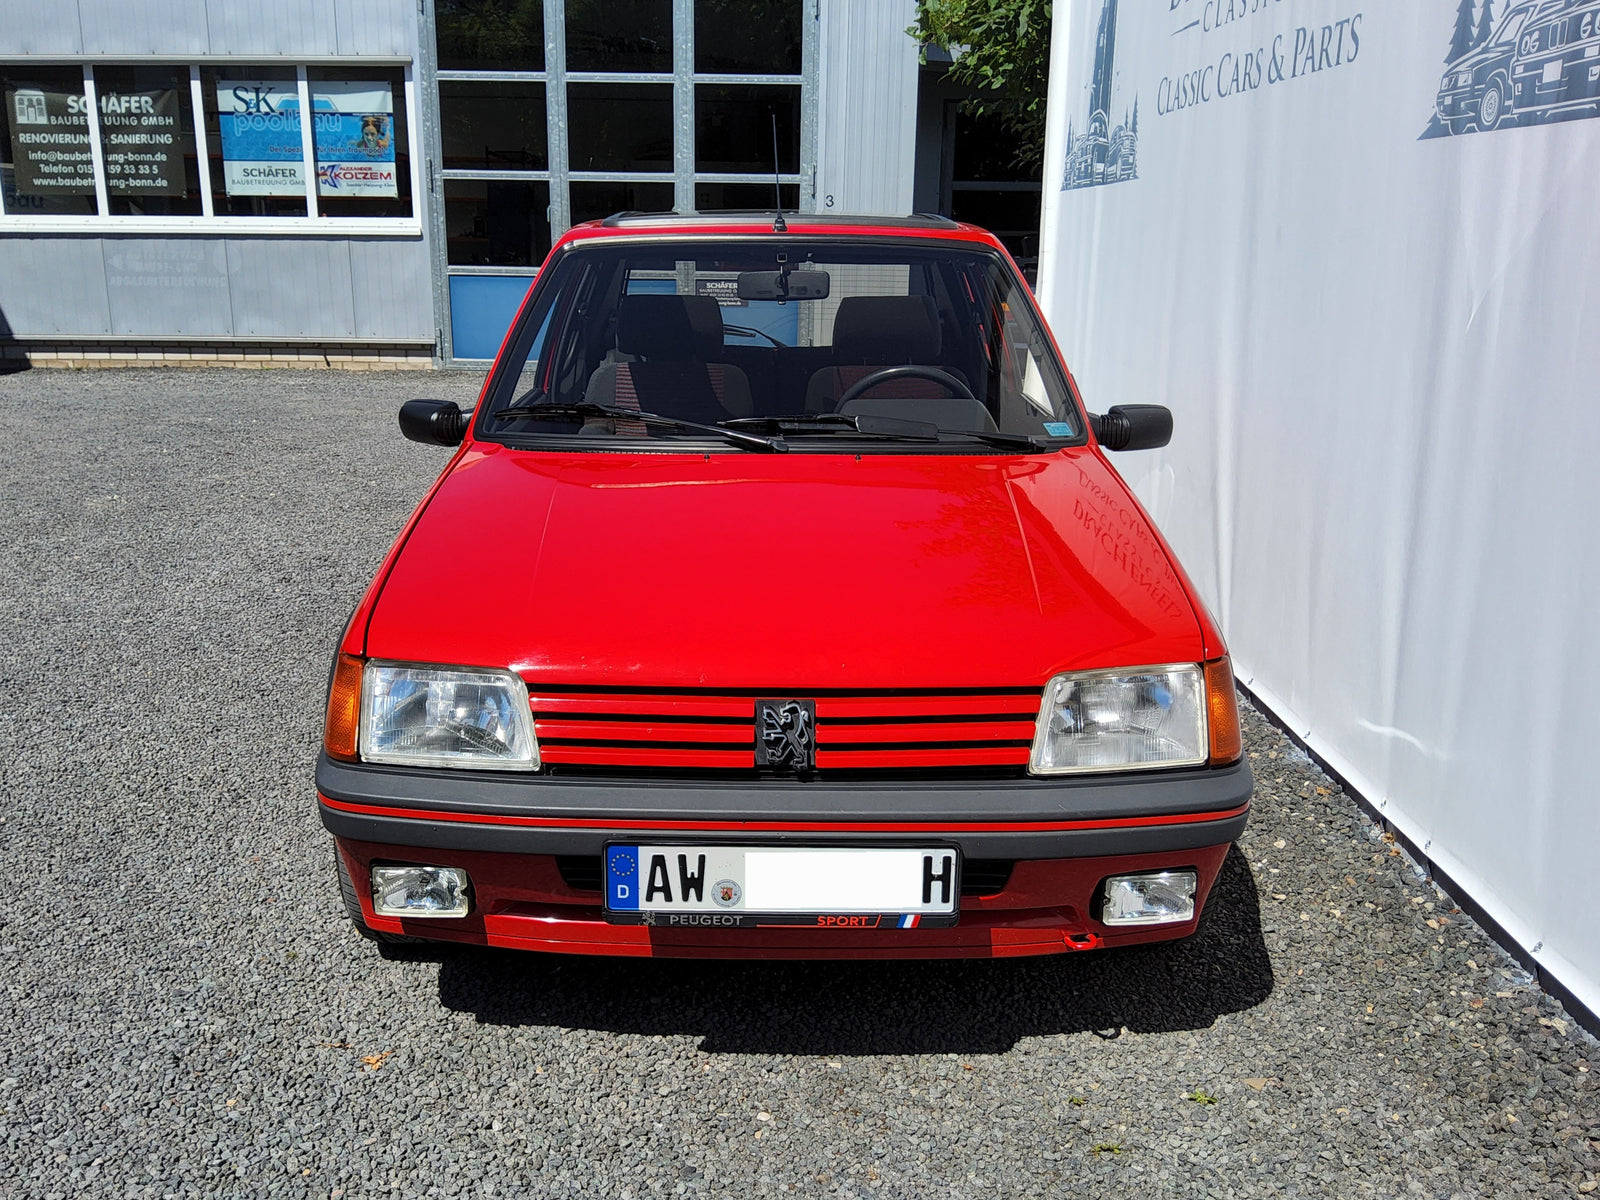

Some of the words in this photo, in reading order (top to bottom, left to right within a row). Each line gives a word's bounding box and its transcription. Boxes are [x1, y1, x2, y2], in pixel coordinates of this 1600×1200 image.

[1157, 65, 1213, 116] CLASSIC
[1217, 48, 1264, 98] CARS
[1267, 34, 1285, 85] &
[1290, 13, 1363, 79] PARTS
[141, 116, 174, 126] GMBH
[19, 133, 92, 145] RENOVIERUN
[110, 133, 173, 145] SANIERUNG
[28, 150, 168, 163] info@baubetung-bonn.de
[39, 163, 75, 174] Telefon
[123, 164, 136, 174] 33
[138, 164, 151, 174] 33
[152, 164, 159, 174] 5
[242, 165, 297, 178] SCHÄFER
[289, 178, 306, 186] GMB
[825, 194, 835, 208] 3
[645, 853, 707, 903] AW
[921, 855, 953, 904] H
[616, 884, 630, 899] D
[669, 914, 744, 926] PEUGEOT
[817, 914, 870, 927] SPORT
